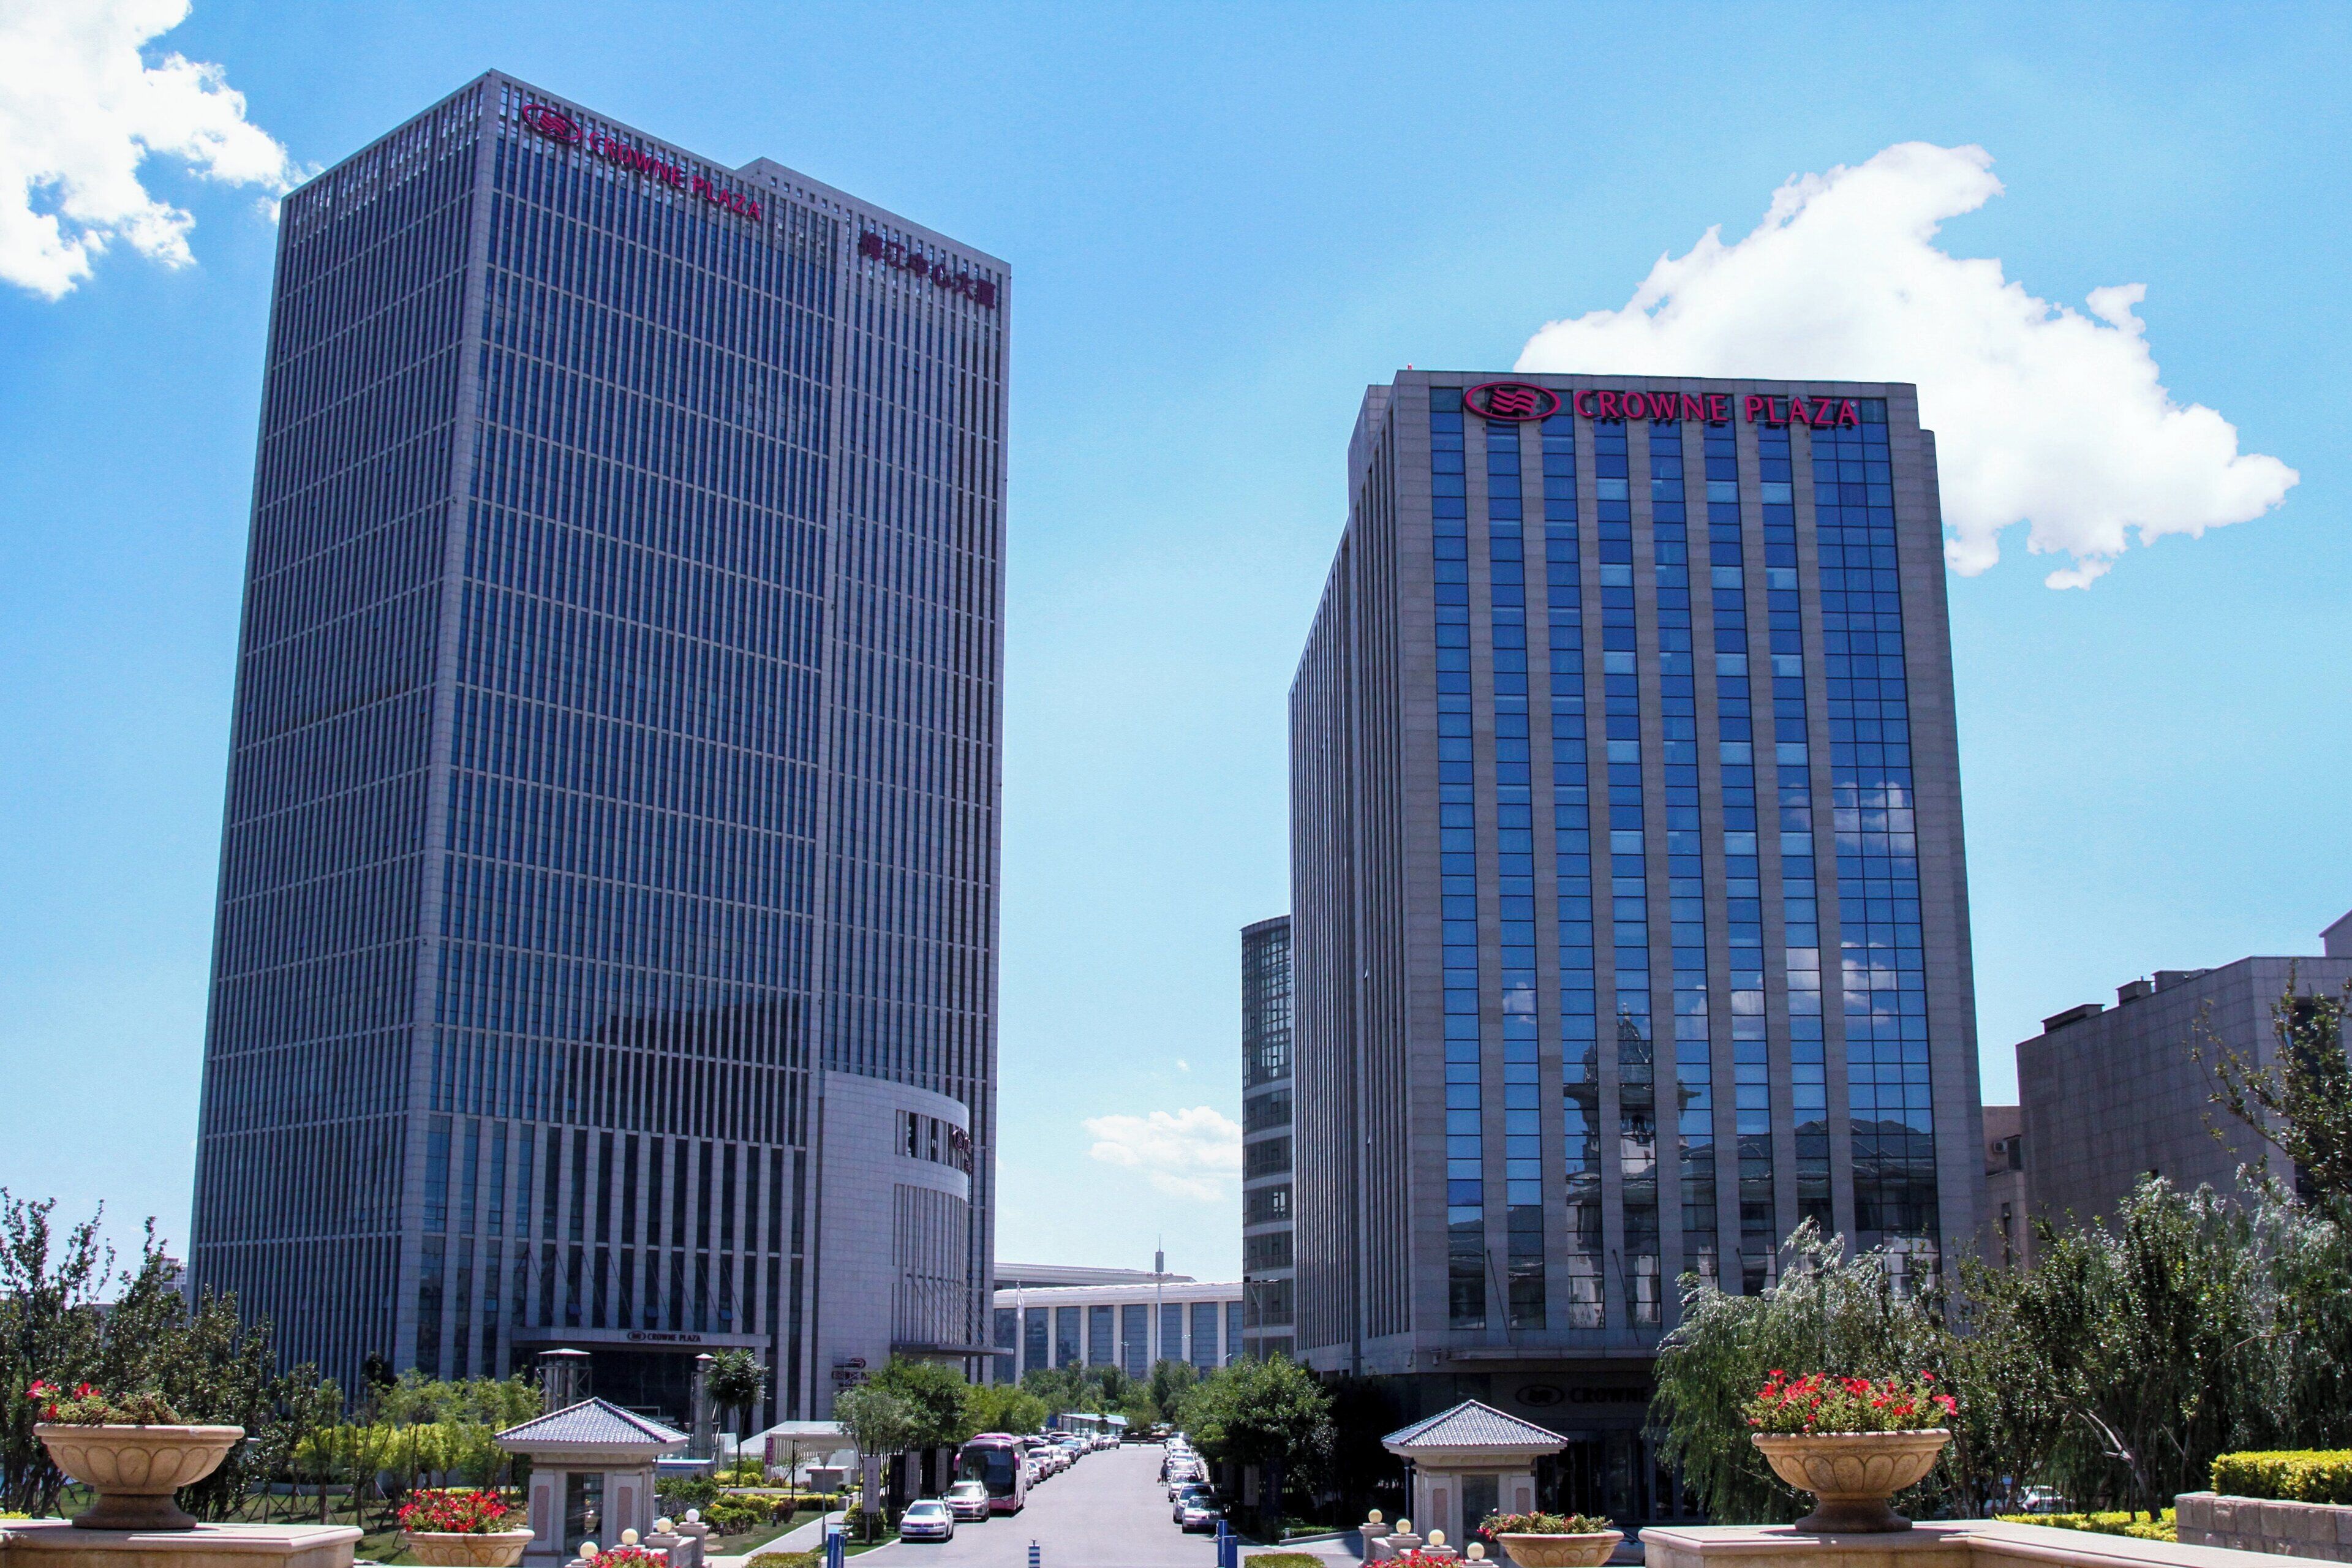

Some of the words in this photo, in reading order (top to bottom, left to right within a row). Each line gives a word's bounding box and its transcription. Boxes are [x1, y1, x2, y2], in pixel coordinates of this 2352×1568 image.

[589, 132, 681, 186] CROWNE
[692, 175, 761, 221] PLAZA
[1574, 390, 1728, 421] CROWNE
[1744, 395, 1860, 426] PLAZA
[647, 1332, 677, 1341] CROWNE
[679, 1334, 701, 1343] PLAZA
[1570, 1387, 1650, 1403] CROWNE
